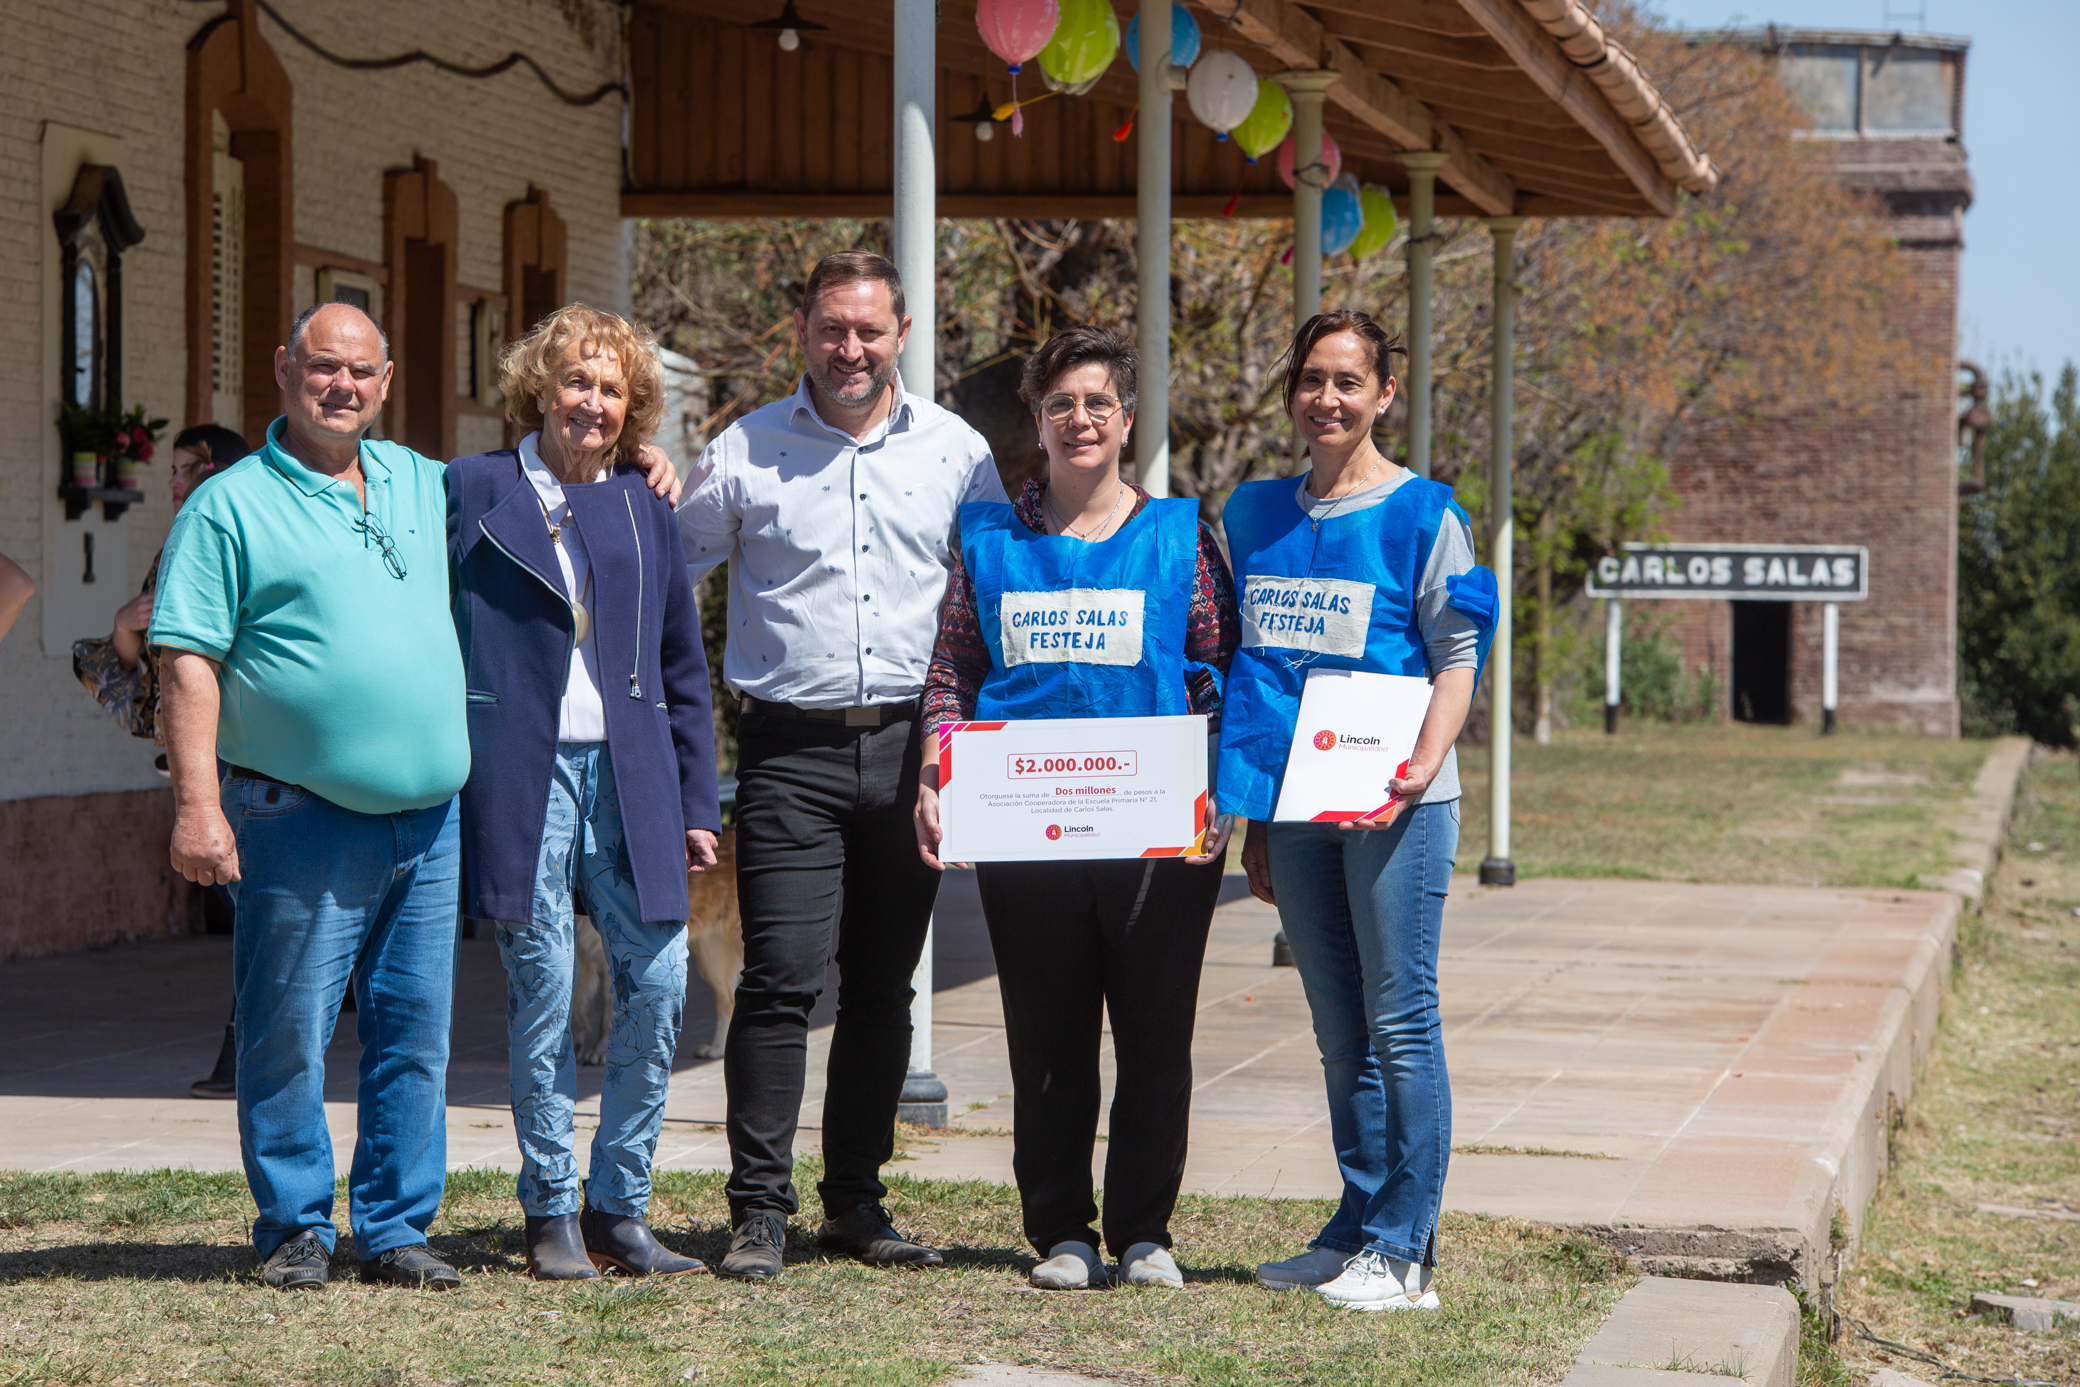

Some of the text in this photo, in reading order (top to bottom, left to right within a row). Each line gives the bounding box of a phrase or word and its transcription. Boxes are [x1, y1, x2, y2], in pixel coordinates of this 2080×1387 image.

[1598, 556, 1855, 586] CARLOS SALAS
[1250, 588, 1351, 615] CARLOS SALAS
[1012, 609, 1129, 628] CARLOS SALAS
[1259, 612, 1325, 635] FESTEJA
[1030, 632, 1105, 650] FESTEJA
[1338, 743, 1389, 752] Municipalidad
[1339, 734, 1380, 745] Lincoln
[1015, 757, 1130, 775] $2.000.000.-
[1055, 787, 1073, 796] Dos
[1075, 786, 1117, 795] millones
[1064, 825, 1094, 833] Lincoln
